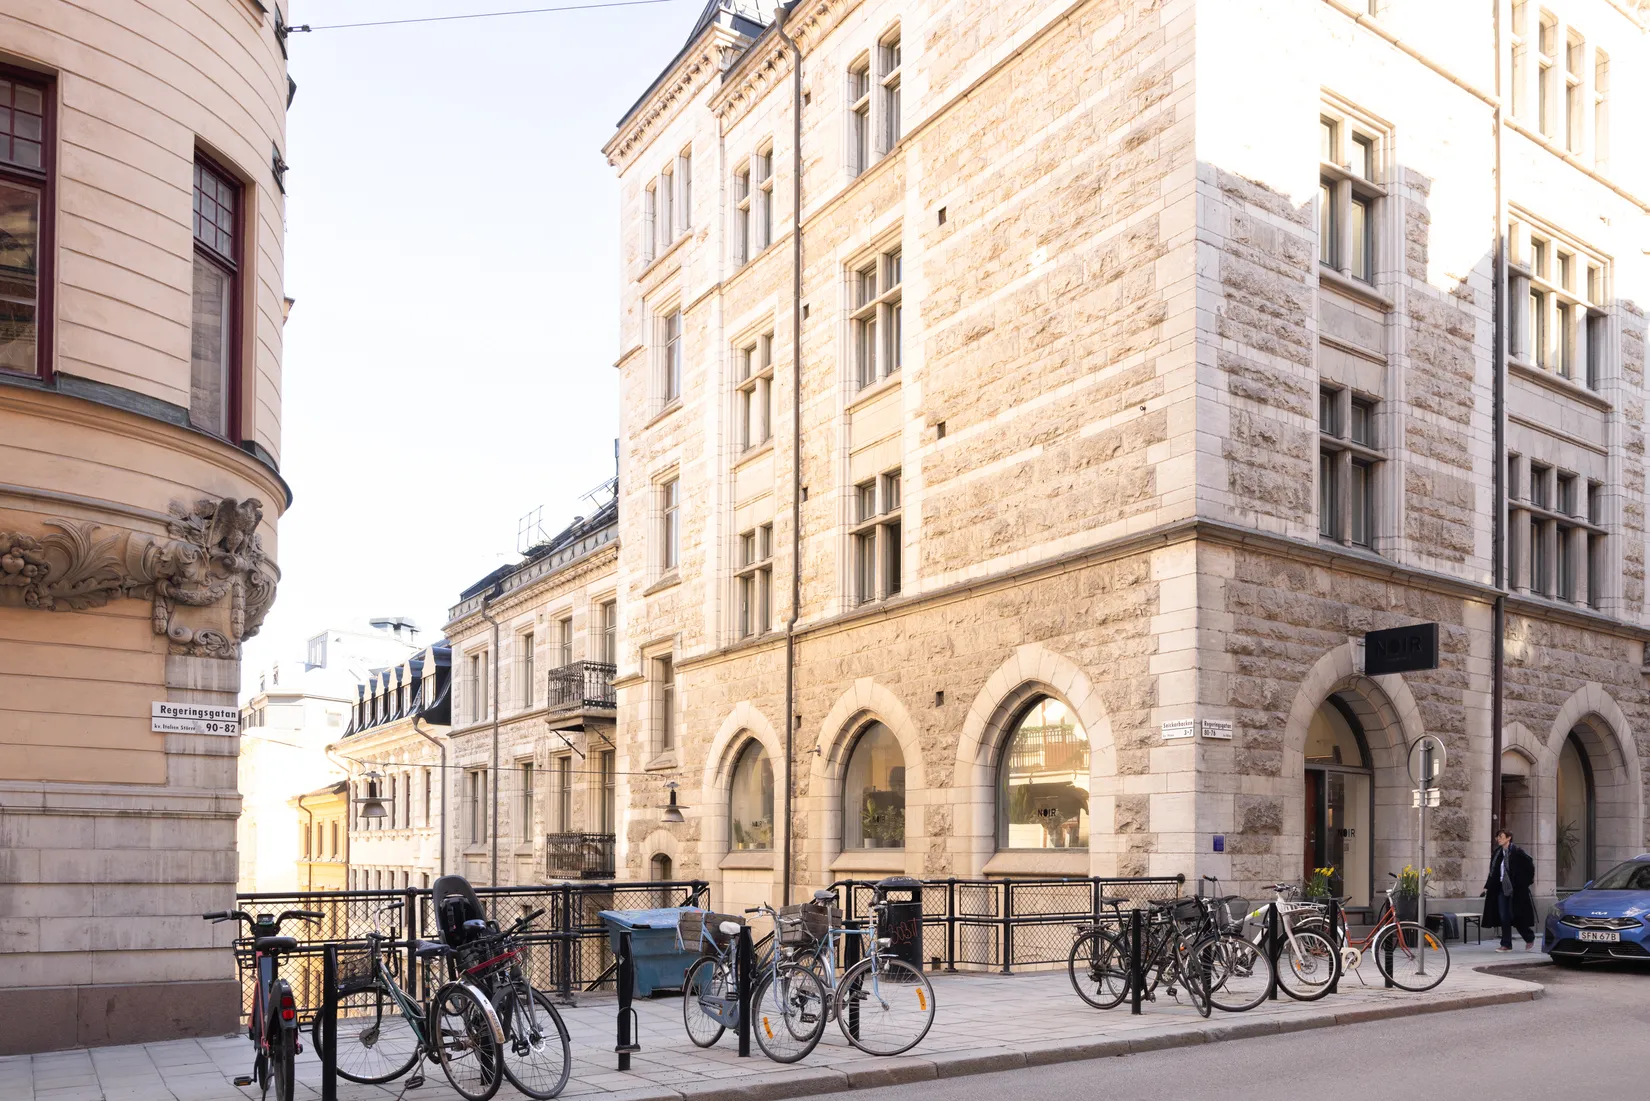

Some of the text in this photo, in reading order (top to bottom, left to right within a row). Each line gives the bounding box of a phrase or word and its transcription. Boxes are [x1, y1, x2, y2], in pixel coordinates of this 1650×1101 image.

[1375, 635, 1423, 658] NOIR
[160, 705, 236, 719] Regeringsgatan
[206, 723, 236, 733] 90-82
[1037, 808, 1056, 817] NOIR
[1337, 828, 1356, 838] NOIR
[1582, 932, 1617, 940] SFN 67B
